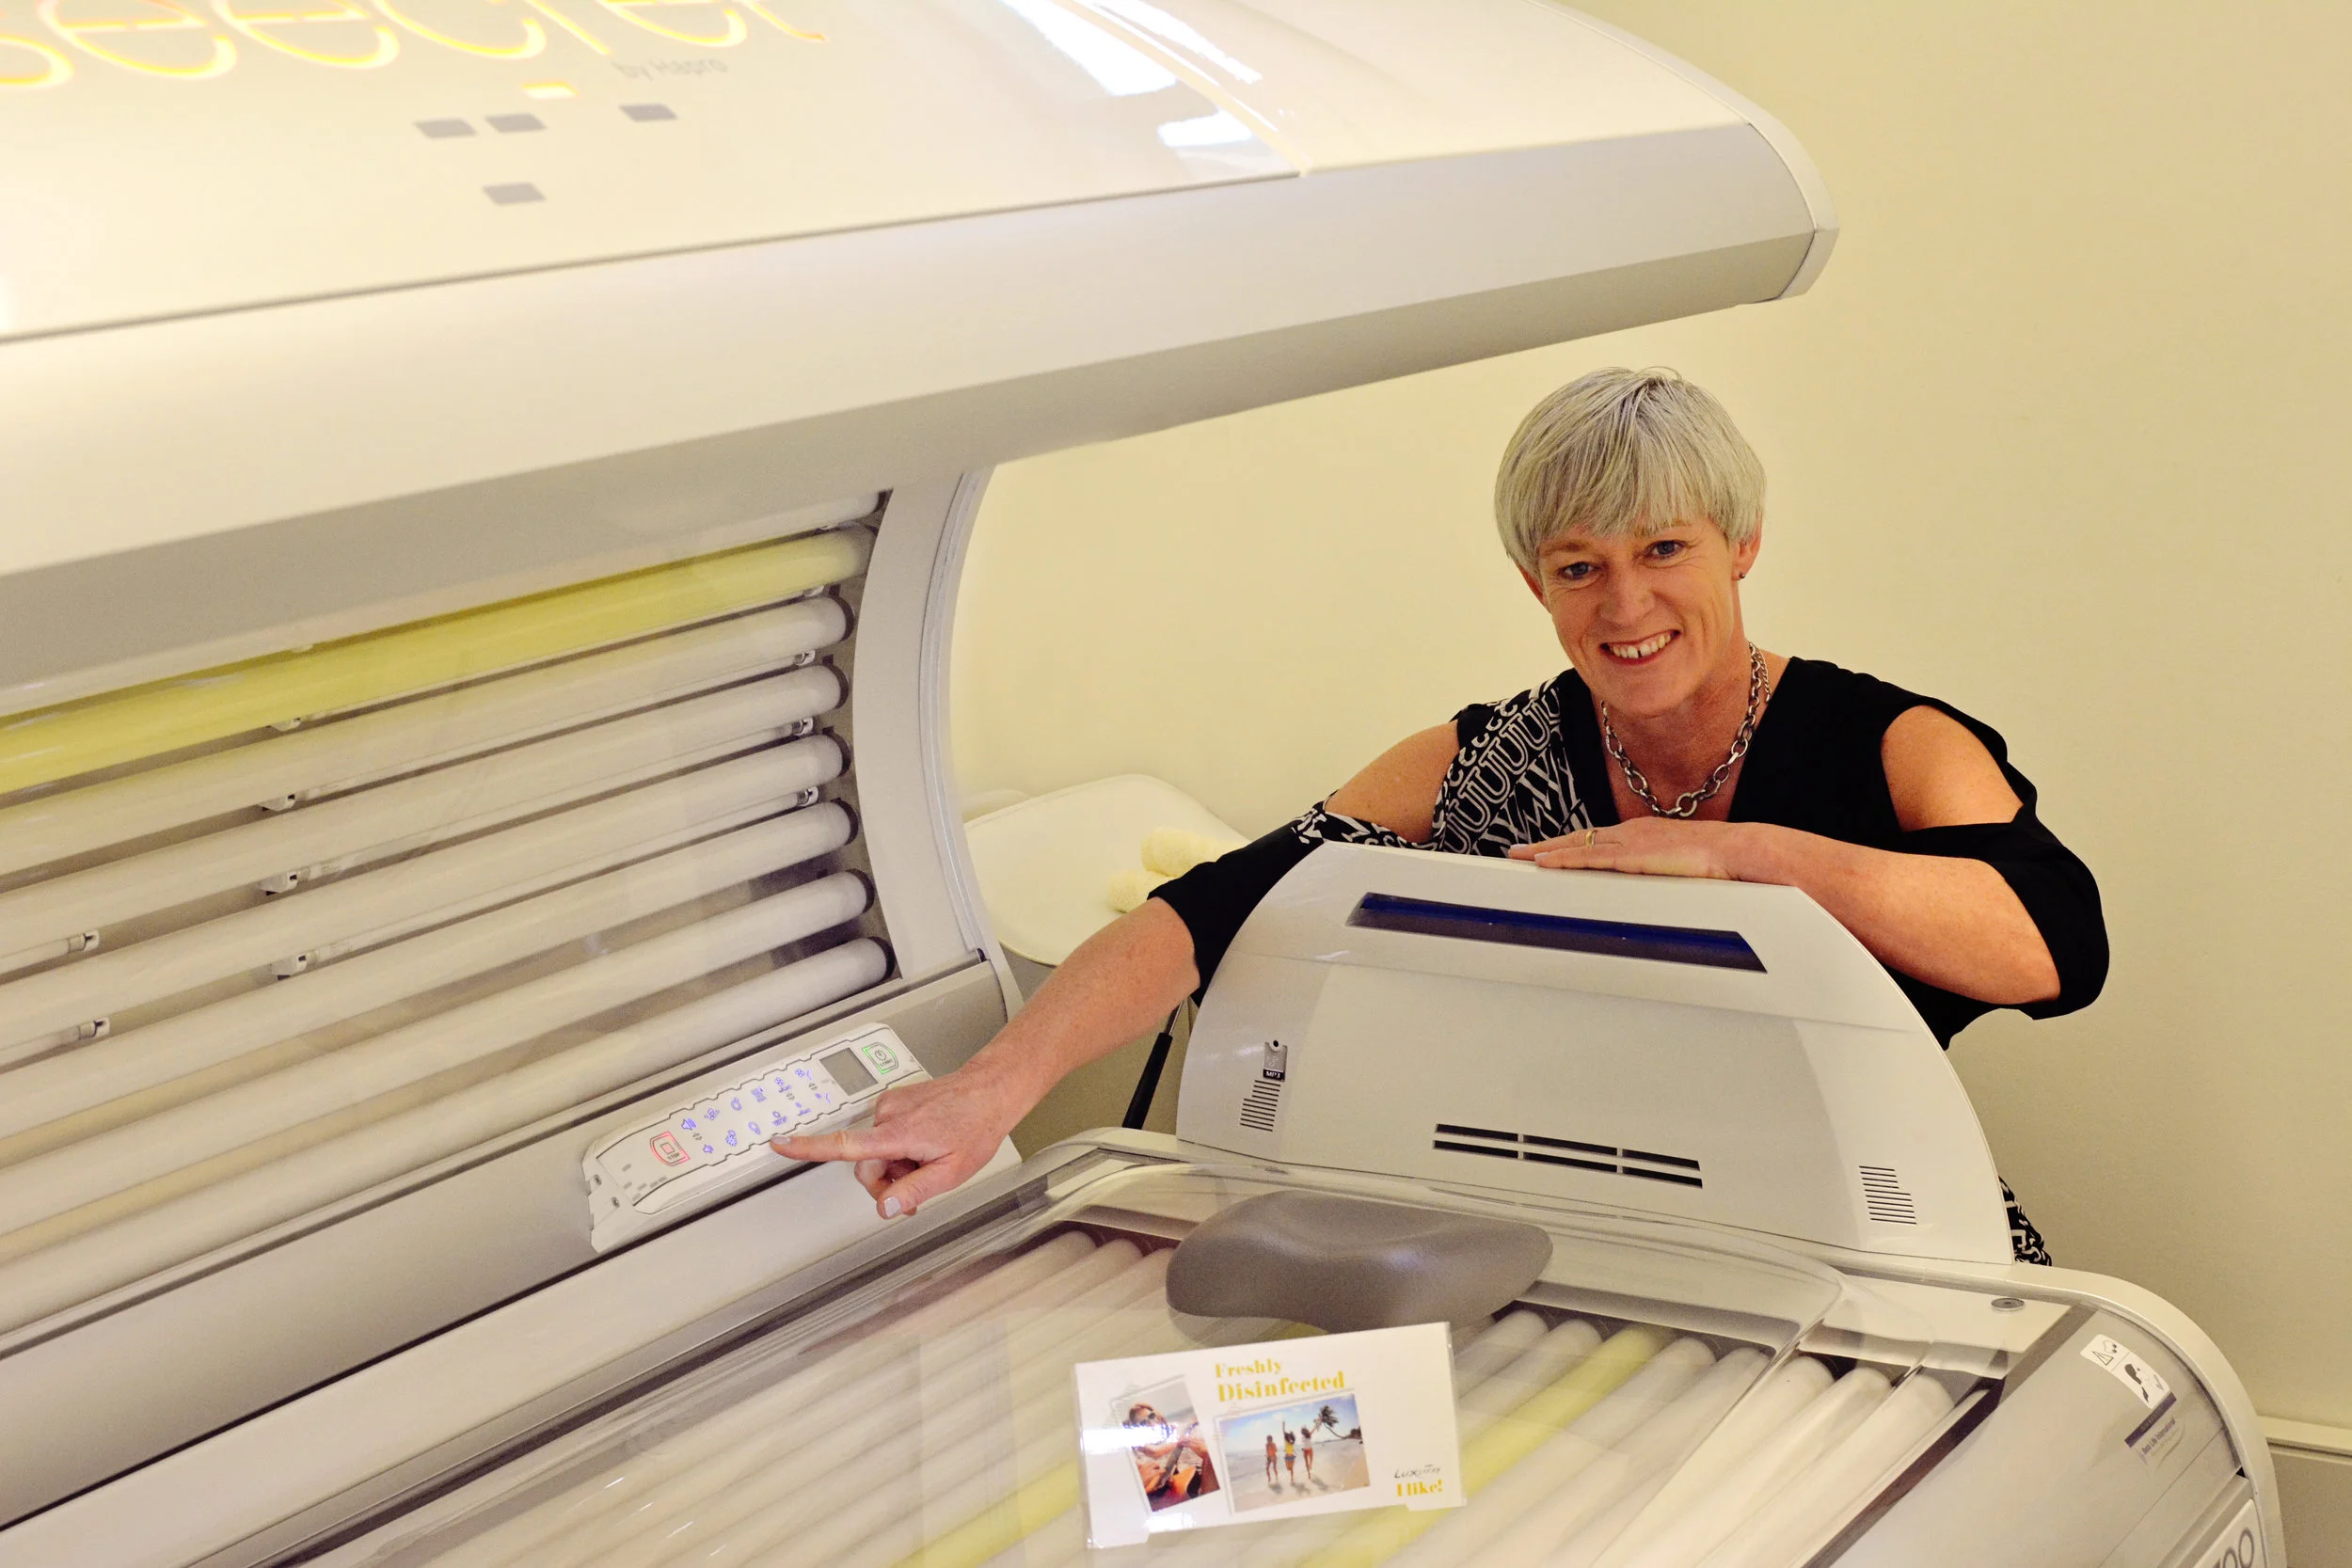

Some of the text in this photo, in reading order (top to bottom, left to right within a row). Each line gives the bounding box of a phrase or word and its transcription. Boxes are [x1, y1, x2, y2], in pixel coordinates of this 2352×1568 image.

[1215, 1358, 1282, 1378] Freshly
[1217, 1370, 1344, 1402] Disinfected
[2212, 1528, 2255, 1568] 00
